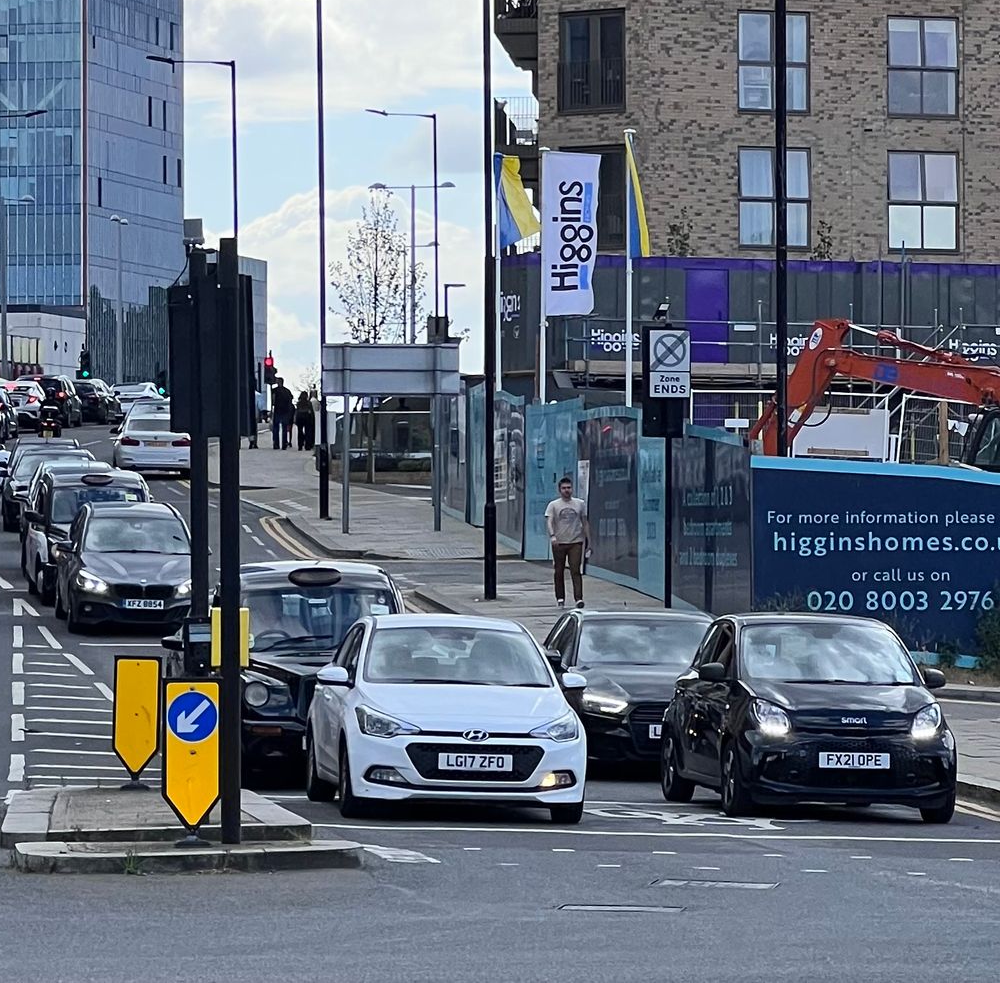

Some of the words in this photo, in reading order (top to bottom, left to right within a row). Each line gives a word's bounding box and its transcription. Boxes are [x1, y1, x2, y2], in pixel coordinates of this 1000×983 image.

[551, 181, 594, 291] Higgins
[659, 375, 680, 383] Zone
[654, 385, 686, 394] ENDS
[767, 510, 793, 524] For
[798, 513, 840, 524] more
[845, 510, 939, 524] information
[945, 511, 996, 527] please
[773, 531, 1000, 557] higginshomes.co.
[851, 572, 868, 582] or
[873, 569, 902, 582] call
[907, 571, 925, 582] us
[930, 571, 951, 582] on
[806, 590, 854, 611] 020
[865, 590, 929, 611] 8003
[940, 590, 995, 611] 2976
[841, 716, 868, 725] smart
[446, 754, 476, 768] LG17
[479, 756, 505, 769] ZFO
[826, 753, 855, 766] FX21
[857, 754, 882, 767] OPE
